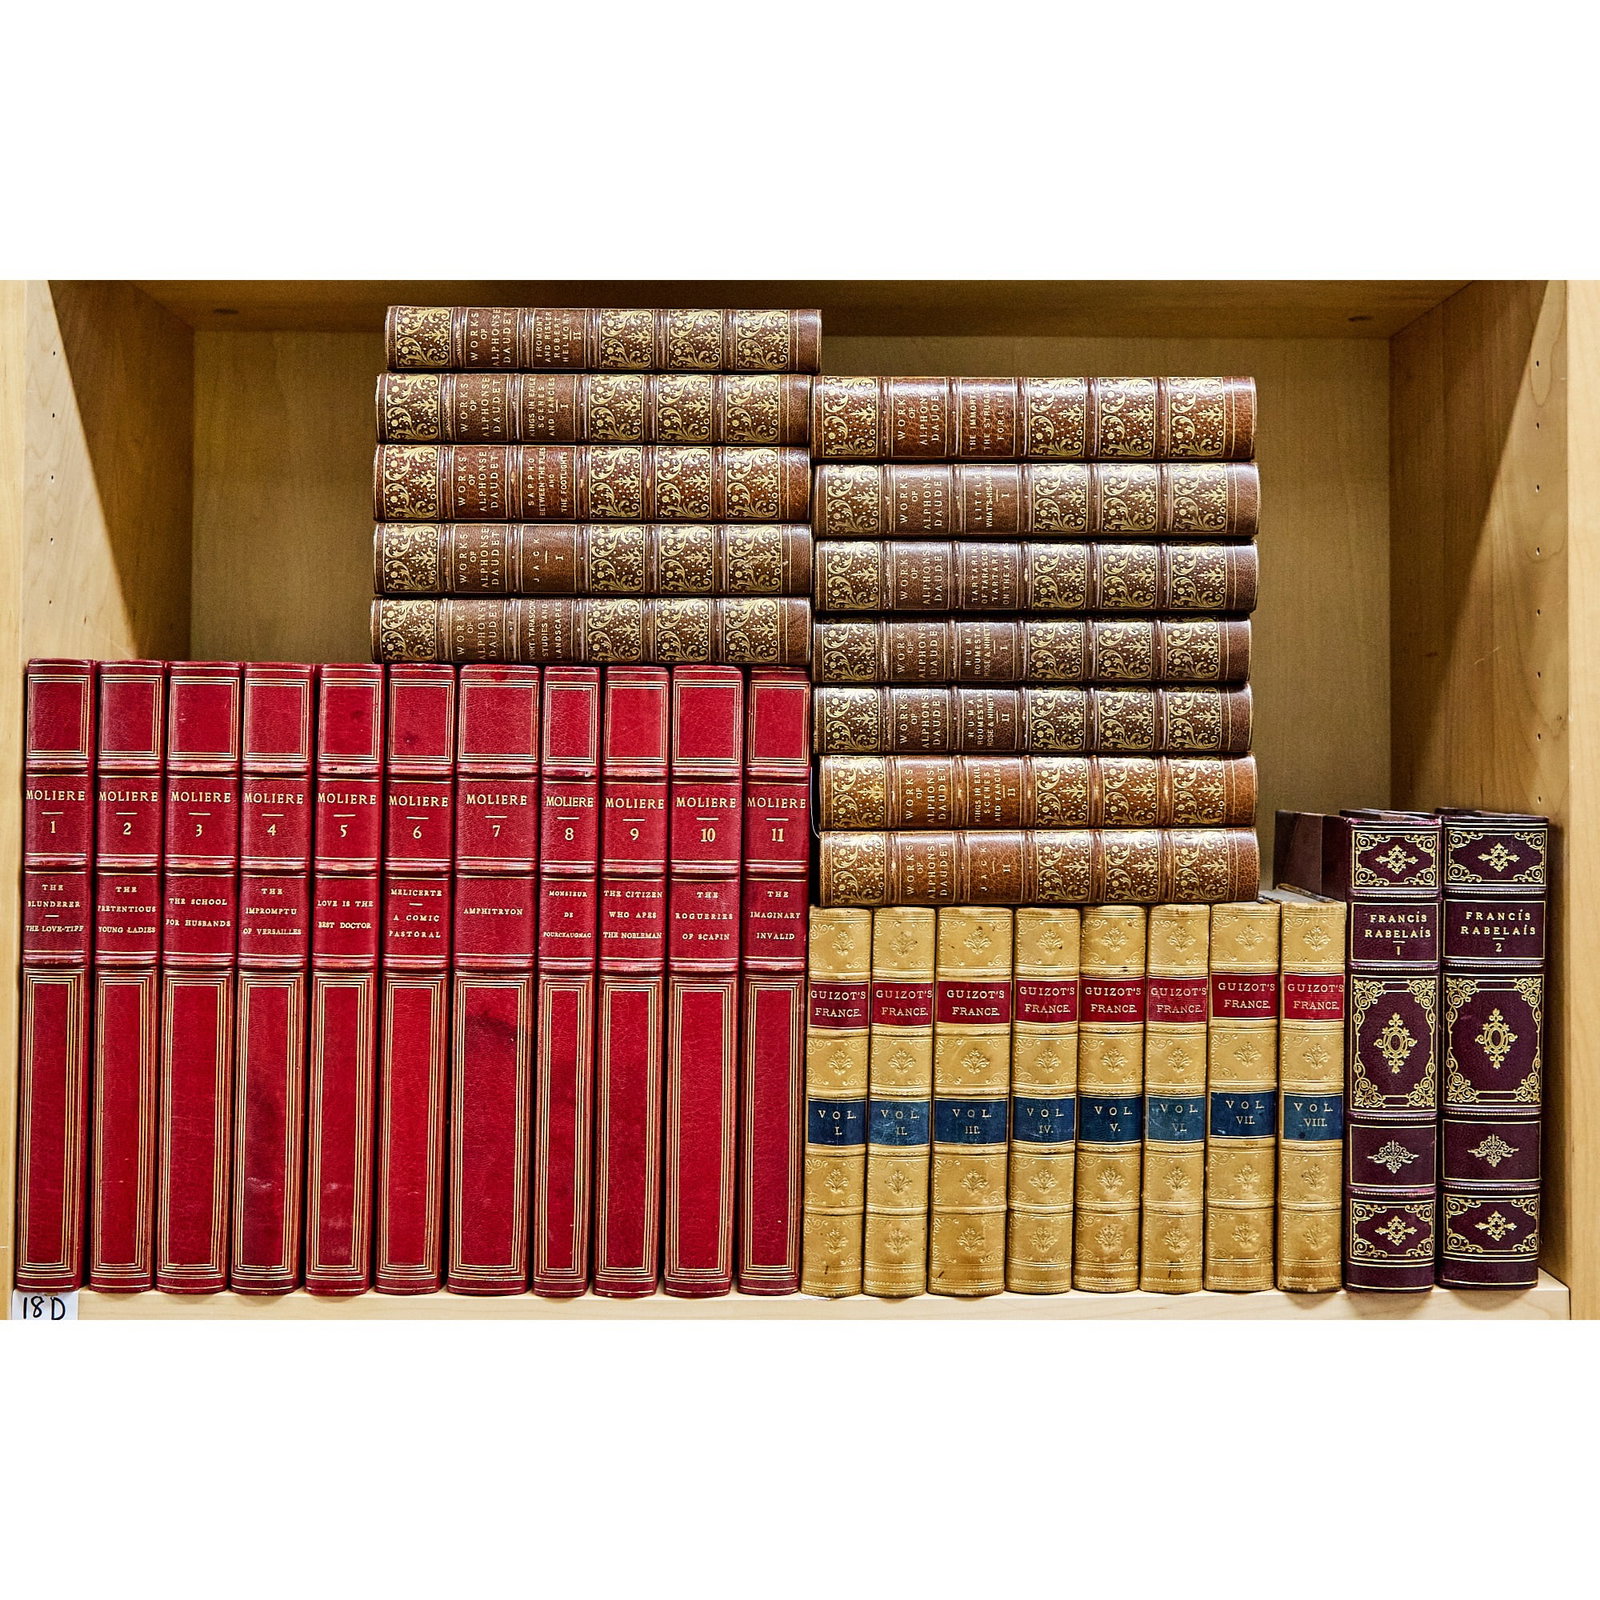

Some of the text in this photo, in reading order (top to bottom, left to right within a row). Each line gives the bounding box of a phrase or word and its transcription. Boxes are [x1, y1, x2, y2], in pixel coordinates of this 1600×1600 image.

[481, 329, 487, 340] OF
[503, 312, 511, 363] DAUDET
[573, 331, 580, 340] II
[460, 383, 468, 432] WORKS
[470, 400, 476, 411] OF
[492, 380, 500, 432] DAUDET
[909, 407, 916, 419] OF
[458, 457, 466, 506] WORKS
[468, 474, 475, 485] OF
[479, 452, 487, 512] ALPHONSE
[900, 474, 908, 523] WORKS
[912, 491, 918, 502] OF
[934, 471, 942, 526] DAUDET
[460, 534, 468, 583] WORKS
[470, 551, 476, 562] OF
[481, 528, 489, 588] ALPHONSE
[492, 532, 500, 585] DAUDET
[489, 604, 497, 656] DAUDET
[897, 624, 905, 673] WORKS
[900, 694, 908, 743] WORKS
[911, 714, 917, 724] OF
[1002, 713, 1009, 722] II
[26, 791, 85, 800] MOLIERE
[99, 792, 157, 802] MOLIERE
[171, 792, 231, 802] MOLIERE
[244, 793, 304, 804] MOLIERE
[916, 788, 922, 799] OF
[938, 767, 946, 819] DAUDET
[318, 793, 376, 805] MOLIERE
[389, 796, 448, 807] MOLIERE
[466, 794, 527, 805] MOLIERE
[546, 797, 594, 807] MOLIERE
[605, 798, 664, 809] MOLIERE
[676, 798, 736, 808] MOLIERE
[747, 798, 806, 808] MOLIERE
[51, 821, 56, 833] 1
[123, 823, 131, 835] 2
[196, 825, 202, 837] 3
[267, 824, 276, 836] 4
[340, 824, 348, 837] 5
[413, 826, 422, 839] 6
[492, 825, 500, 837] 7
[565, 828, 574, 840] 8
[630, 828, 639, 840] 9
[700, 828, 715, 842] 10
[772, 829, 784, 842] 11
[906, 845, 914, 895] WORKS
[1396, 946, 1400, 955] 1
[1496, 943, 1502, 952] 2
[1020, 987, 1075, 996] GUIZOT'S
[1085, 987, 1141, 996] GUIZOT'S
[1151, 987, 1207, 997] GUIZOT'S
[1218, 983, 1275, 992] GUIZOT'S
[1287, 983, 1344, 993] GUIZOT'S
[811, 990, 866, 1000] GUIZOT'S
[876, 990, 933, 999] GUIZOT'S
[947, 990, 1005, 999] GUIZOT'S
[1025, 1004, 1070, 1014] FRANCE.
[1091, 1004, 1137, 1013] FRANCE.
[1157, 1004, 1203, 1014] FRANCE.
[1224, 1000, 1271, 1009] FRANCE.
[1293, 1001, 1339, 1010] FRANCE.
[815, 1007, 861, 1018] FRANCE.
[881, 1007, 928, 1016] FRANCE.
[952, 1007, 1000, 1016] FRANCE.
[1039, 1125, 1053, 1133] IV.
[1110, 1124, 1120, 1132] V.
[23, 1296, 65, 1320] 18 D
